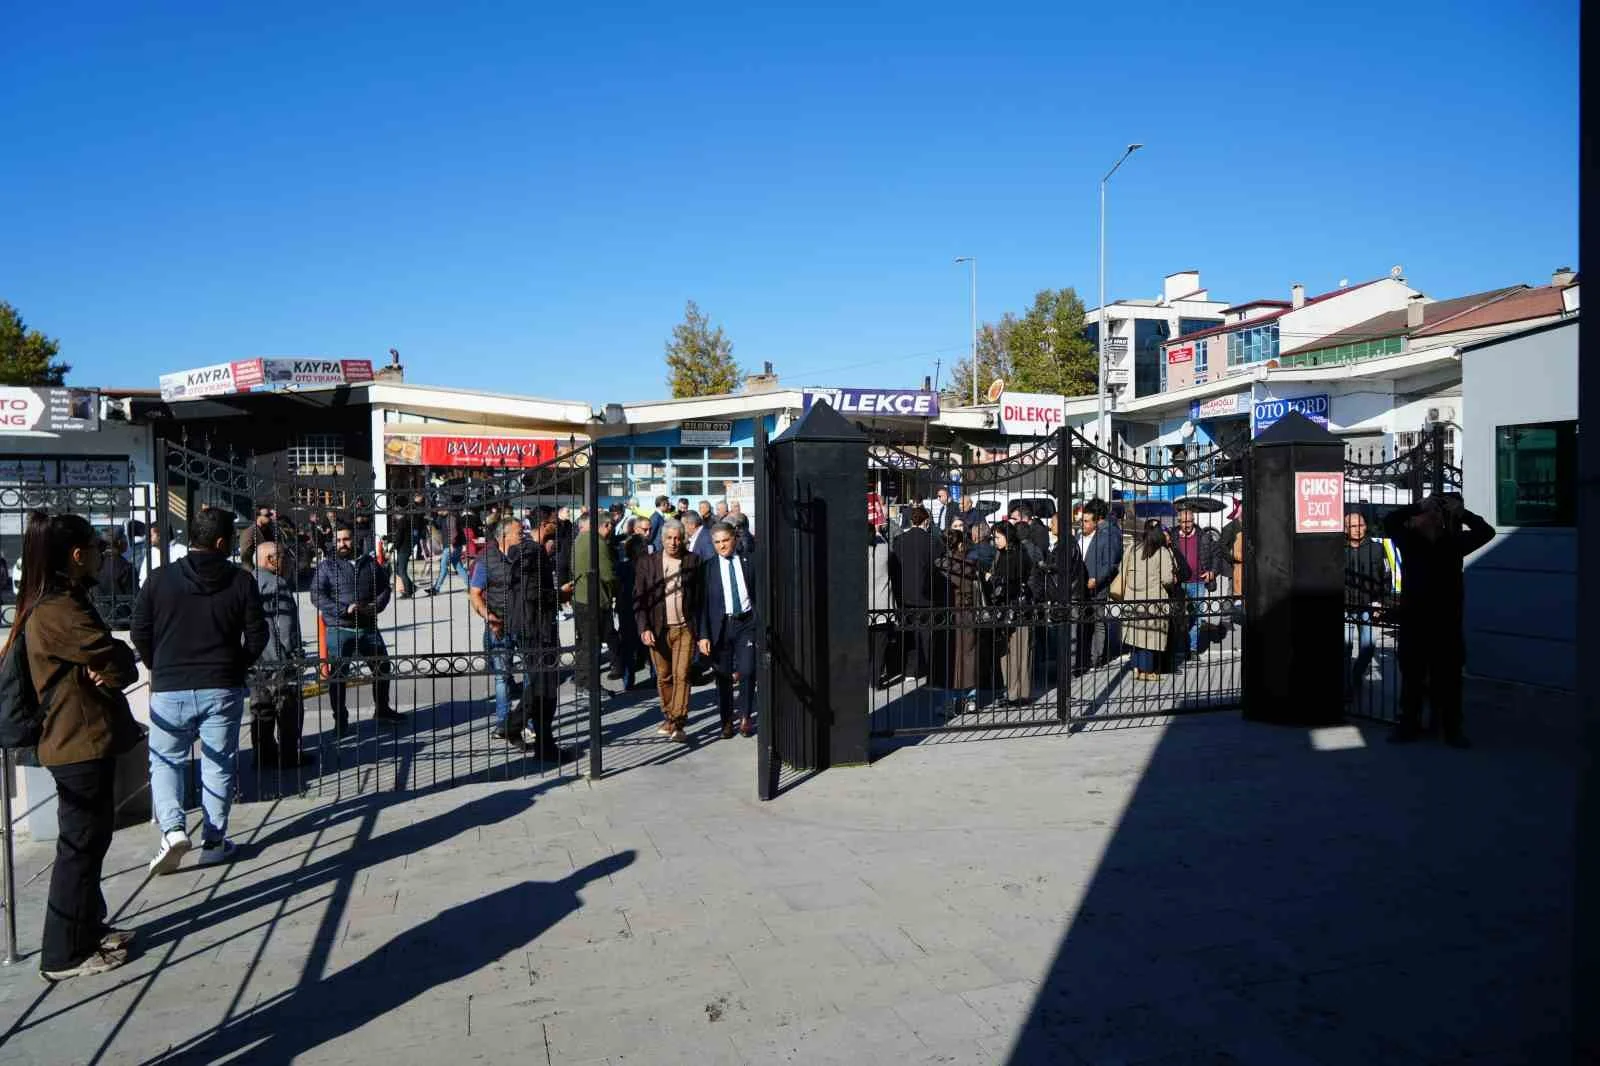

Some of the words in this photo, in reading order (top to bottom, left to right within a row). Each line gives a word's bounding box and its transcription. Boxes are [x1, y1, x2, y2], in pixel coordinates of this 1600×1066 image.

[294, 361, 341, 373] KAYRA
[187, 367, 231, 386] KAYRA
[295, 374, 311, 382] OTO
[313, 374, 342, 383] YIKAMA
[1255, 402, 1284, 419] OTO
[1288, 397, 1327, 415] FORD
[713, 423, 729, 431] OTO
[1301, 478, 1339, 502] ÇIKIŞ
[1308, 502, 1332, 516] EXIT
